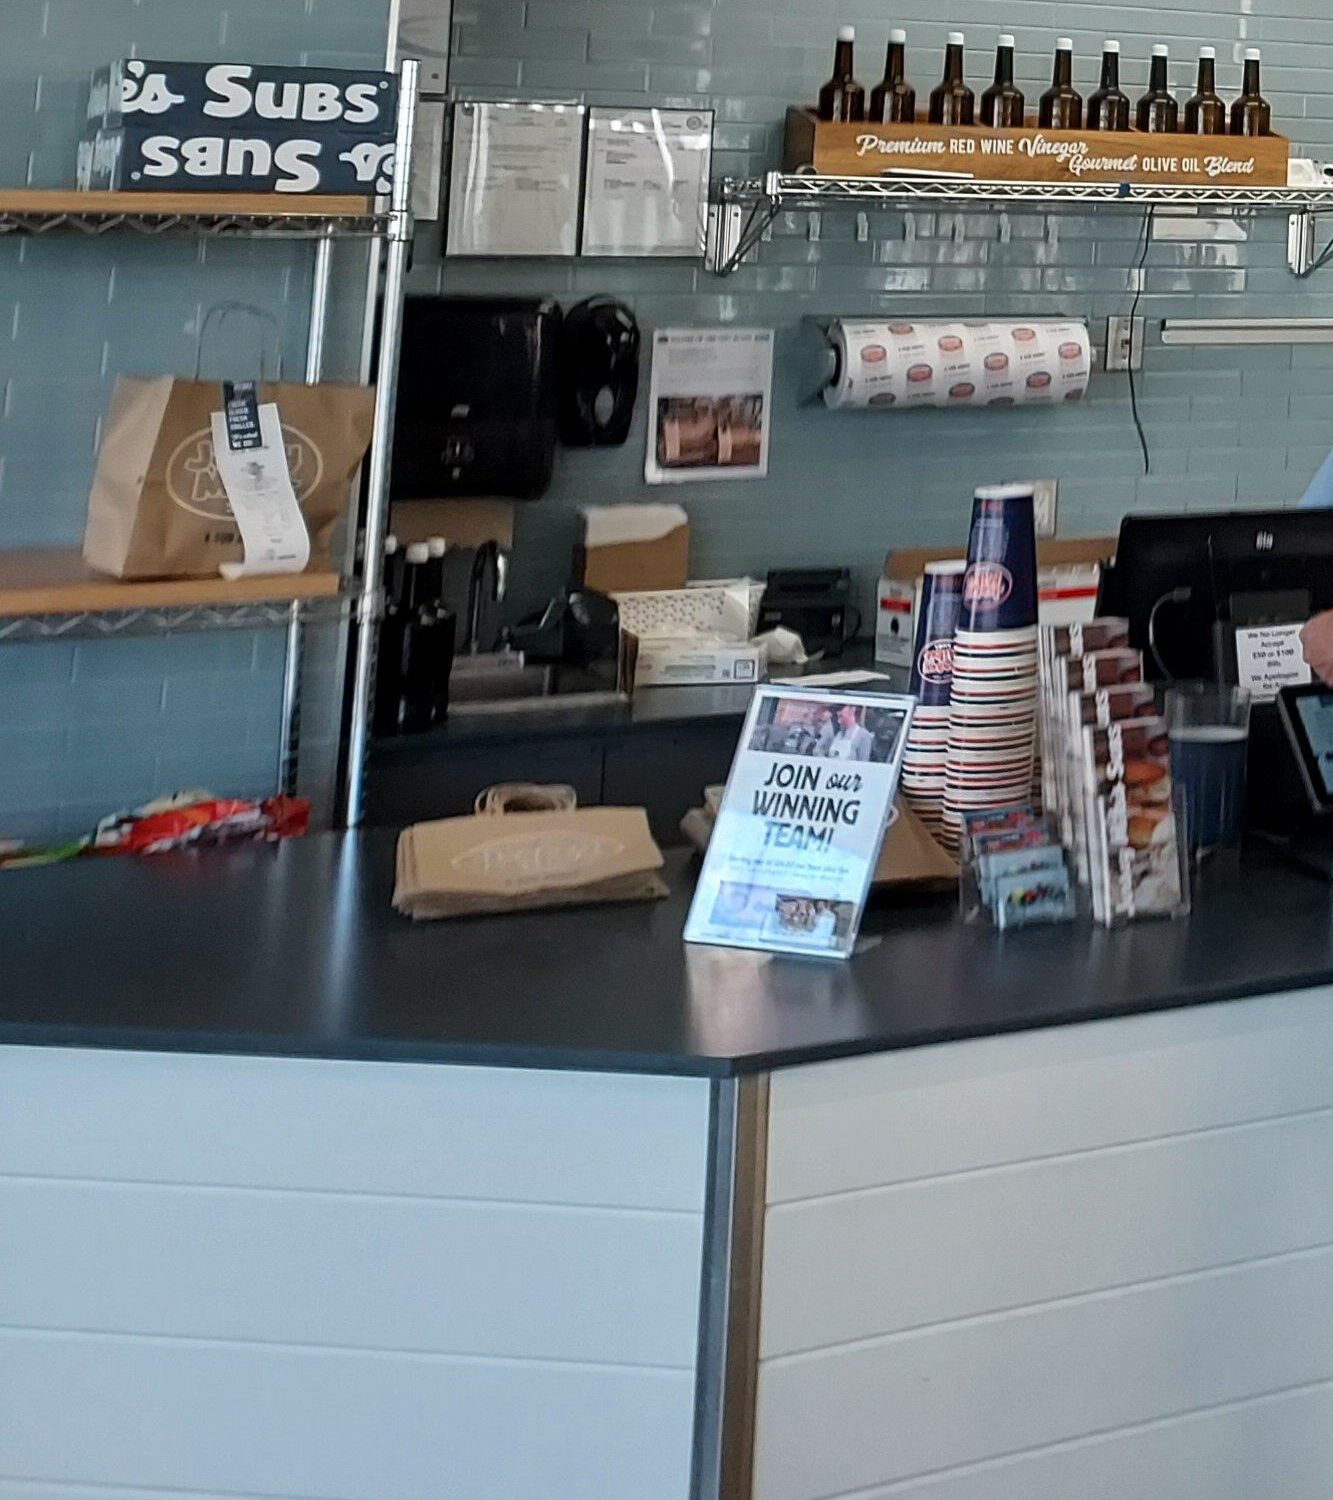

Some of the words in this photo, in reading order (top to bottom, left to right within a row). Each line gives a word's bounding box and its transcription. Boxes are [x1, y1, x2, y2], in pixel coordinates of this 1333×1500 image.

[856, 134, 945, 156] Premium
[950, 138, 975, 154] RED
[980, 139, 1014, 155] WINE
[1018, 134, 1089, 162] Vinegar
[1068, 154, 1138, 176] Gourmet
[1143, 157, 1177, 171] OLIVE
[1182, 158, 1199, 172] OIL
[1204, 156, 1253, 176] Blend
[1272, 629, 1295, 638] Longer
[764, 762, 821, 791] JOIN
[826, 772, 862, 793] our
[753, 790, 860, 825] WINNING
[763, 821, 834, 852] TEAM!
